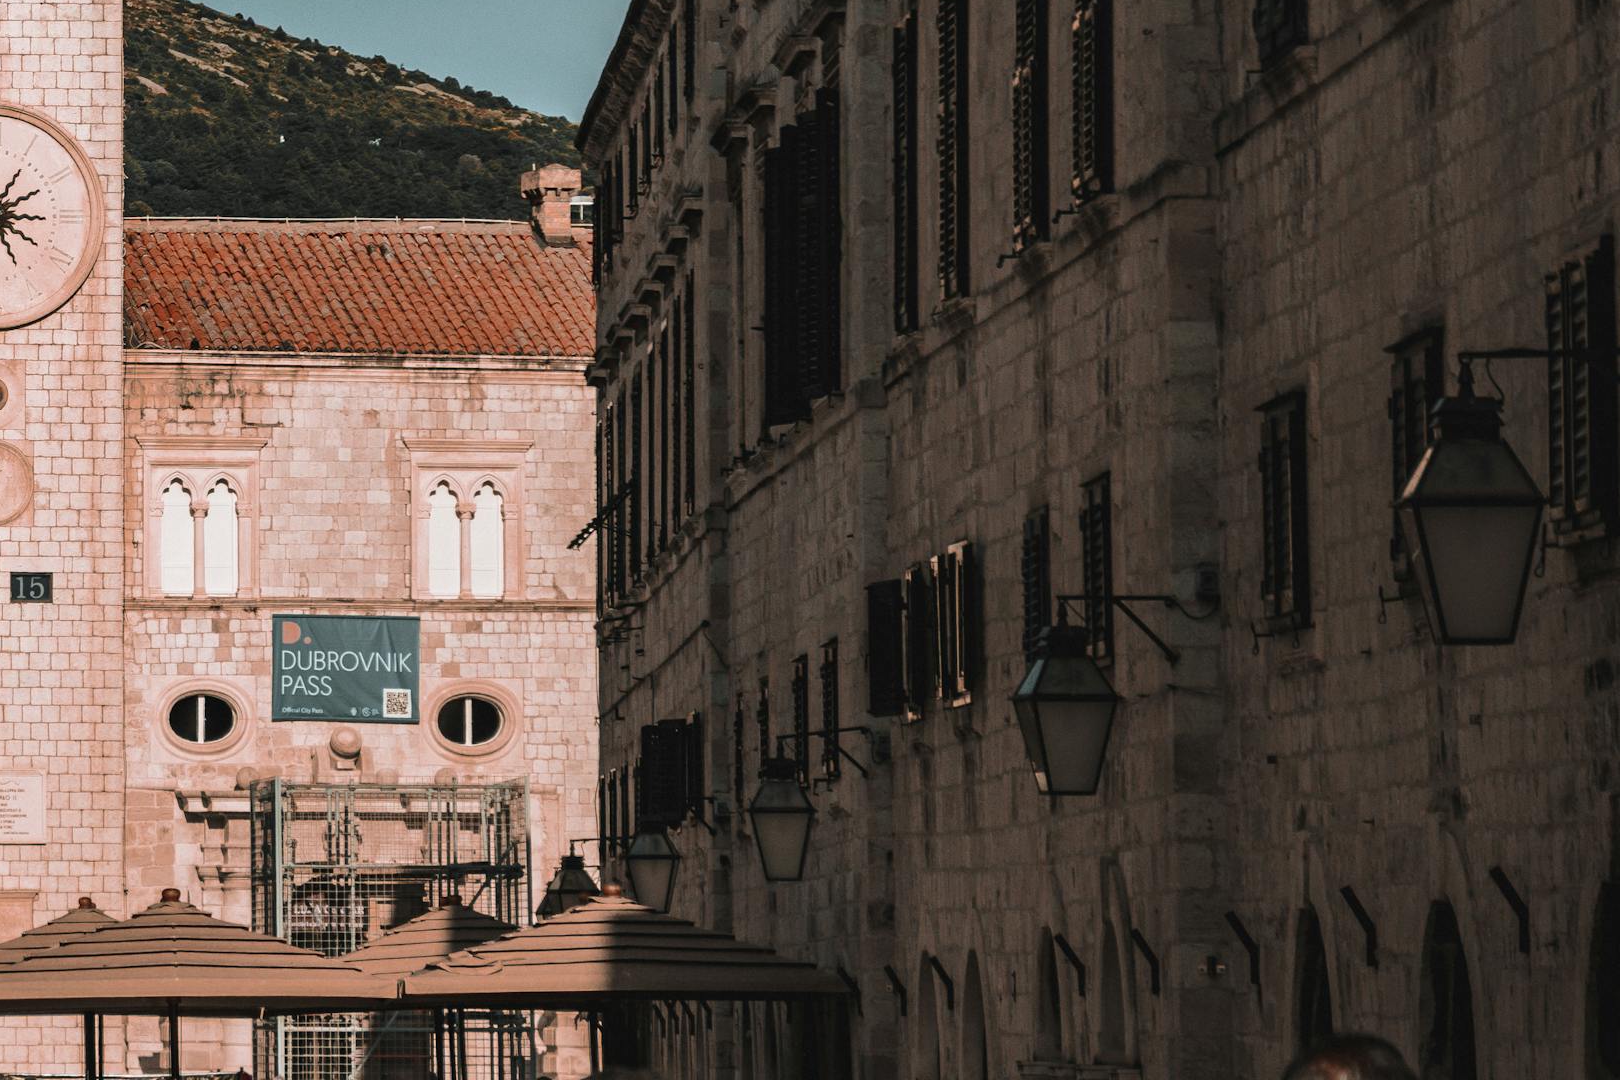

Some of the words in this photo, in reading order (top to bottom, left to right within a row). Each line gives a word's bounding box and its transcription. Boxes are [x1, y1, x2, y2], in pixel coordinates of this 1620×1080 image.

[16, 576, 45, 599] 15
[281, 650, 412, 673] DUBROVNIK
[281, 675, 333, 696] PASS
[301, 707, 311, 715] City
